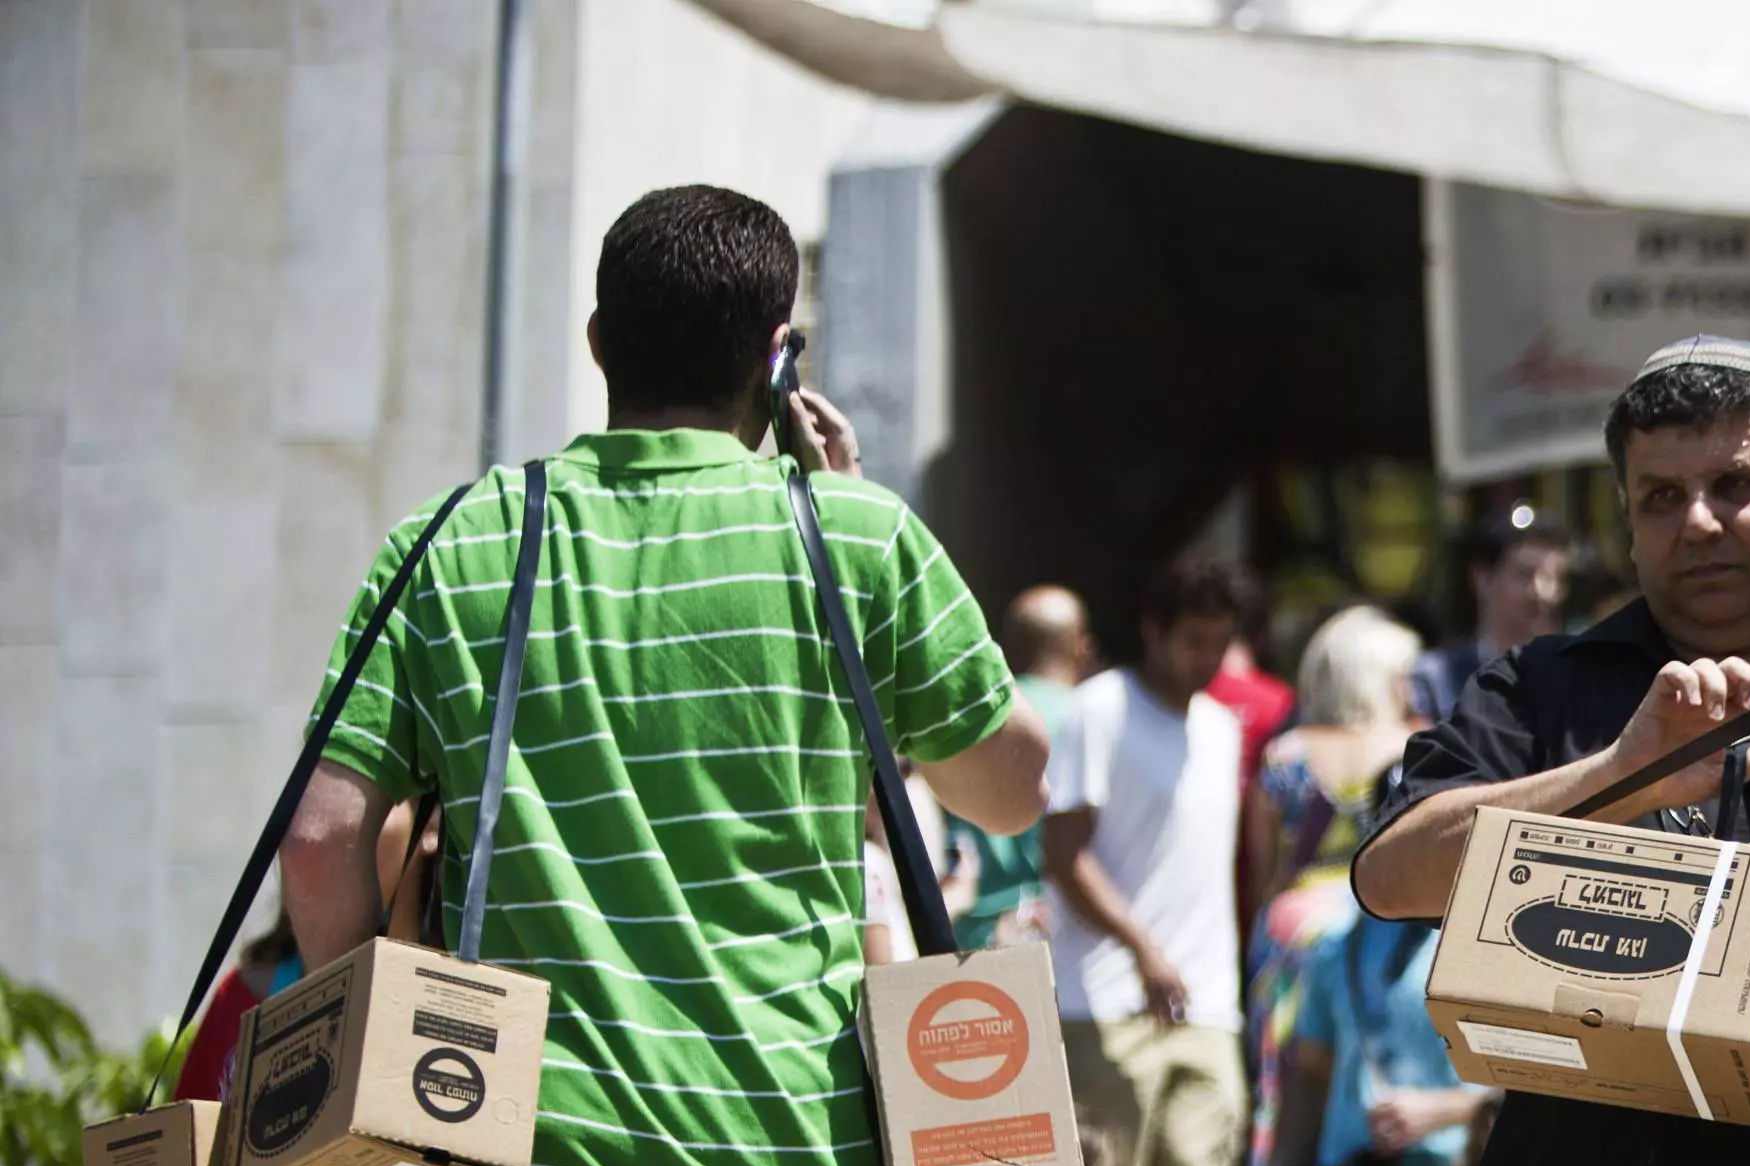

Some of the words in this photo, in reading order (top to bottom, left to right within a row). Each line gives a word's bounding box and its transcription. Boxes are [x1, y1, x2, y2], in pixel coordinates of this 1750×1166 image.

[1578, 883, 1647, 911] למבוגר
[1555, 928, 1610, 952] ערכת
[1614, 935, 1648, 959] מגן
[919, 1023, 970, 1046] לפתוח
[974, 1020, 1013, 1037] אסור
[418, 1079, 443, 1095] אסור
[445, 1085, 477, 1103] לפתוח
